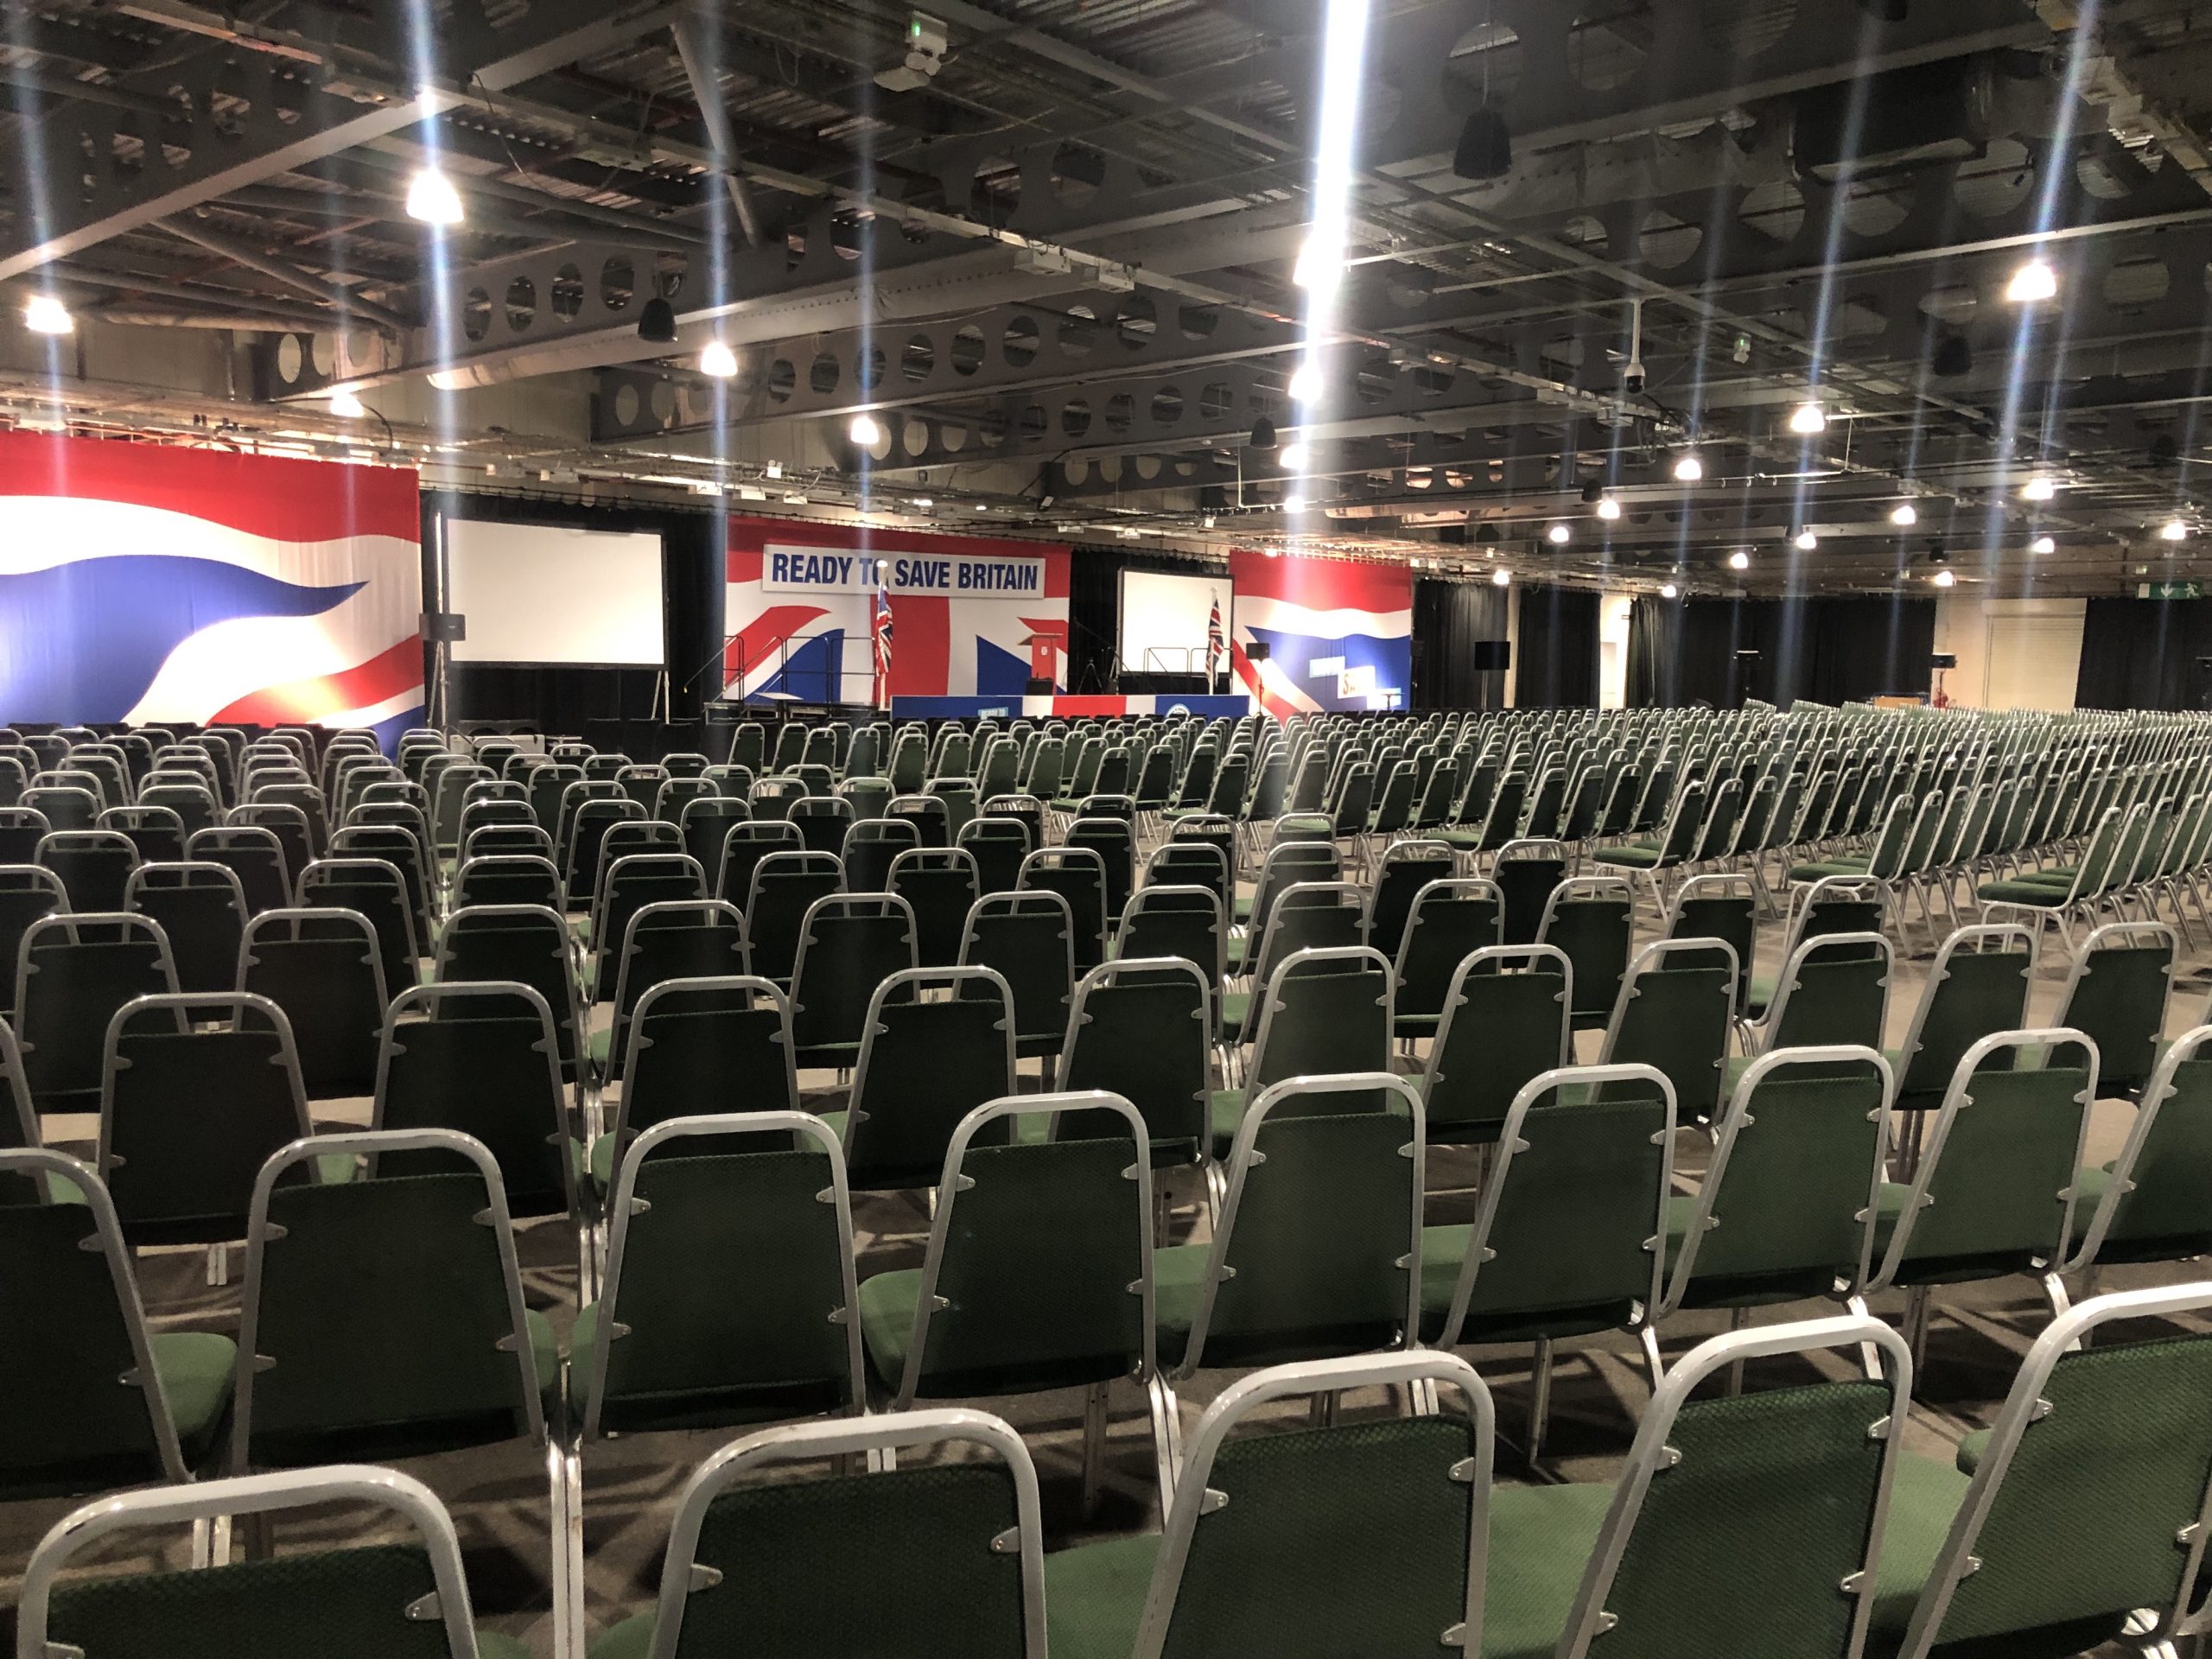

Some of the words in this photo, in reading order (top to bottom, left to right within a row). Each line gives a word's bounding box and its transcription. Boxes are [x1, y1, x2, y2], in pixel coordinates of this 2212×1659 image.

[772, 553, 853, 584] READY
[894, 559, 950, 588] SAVE
[958, 563, 1038, 590] BRITAIN
